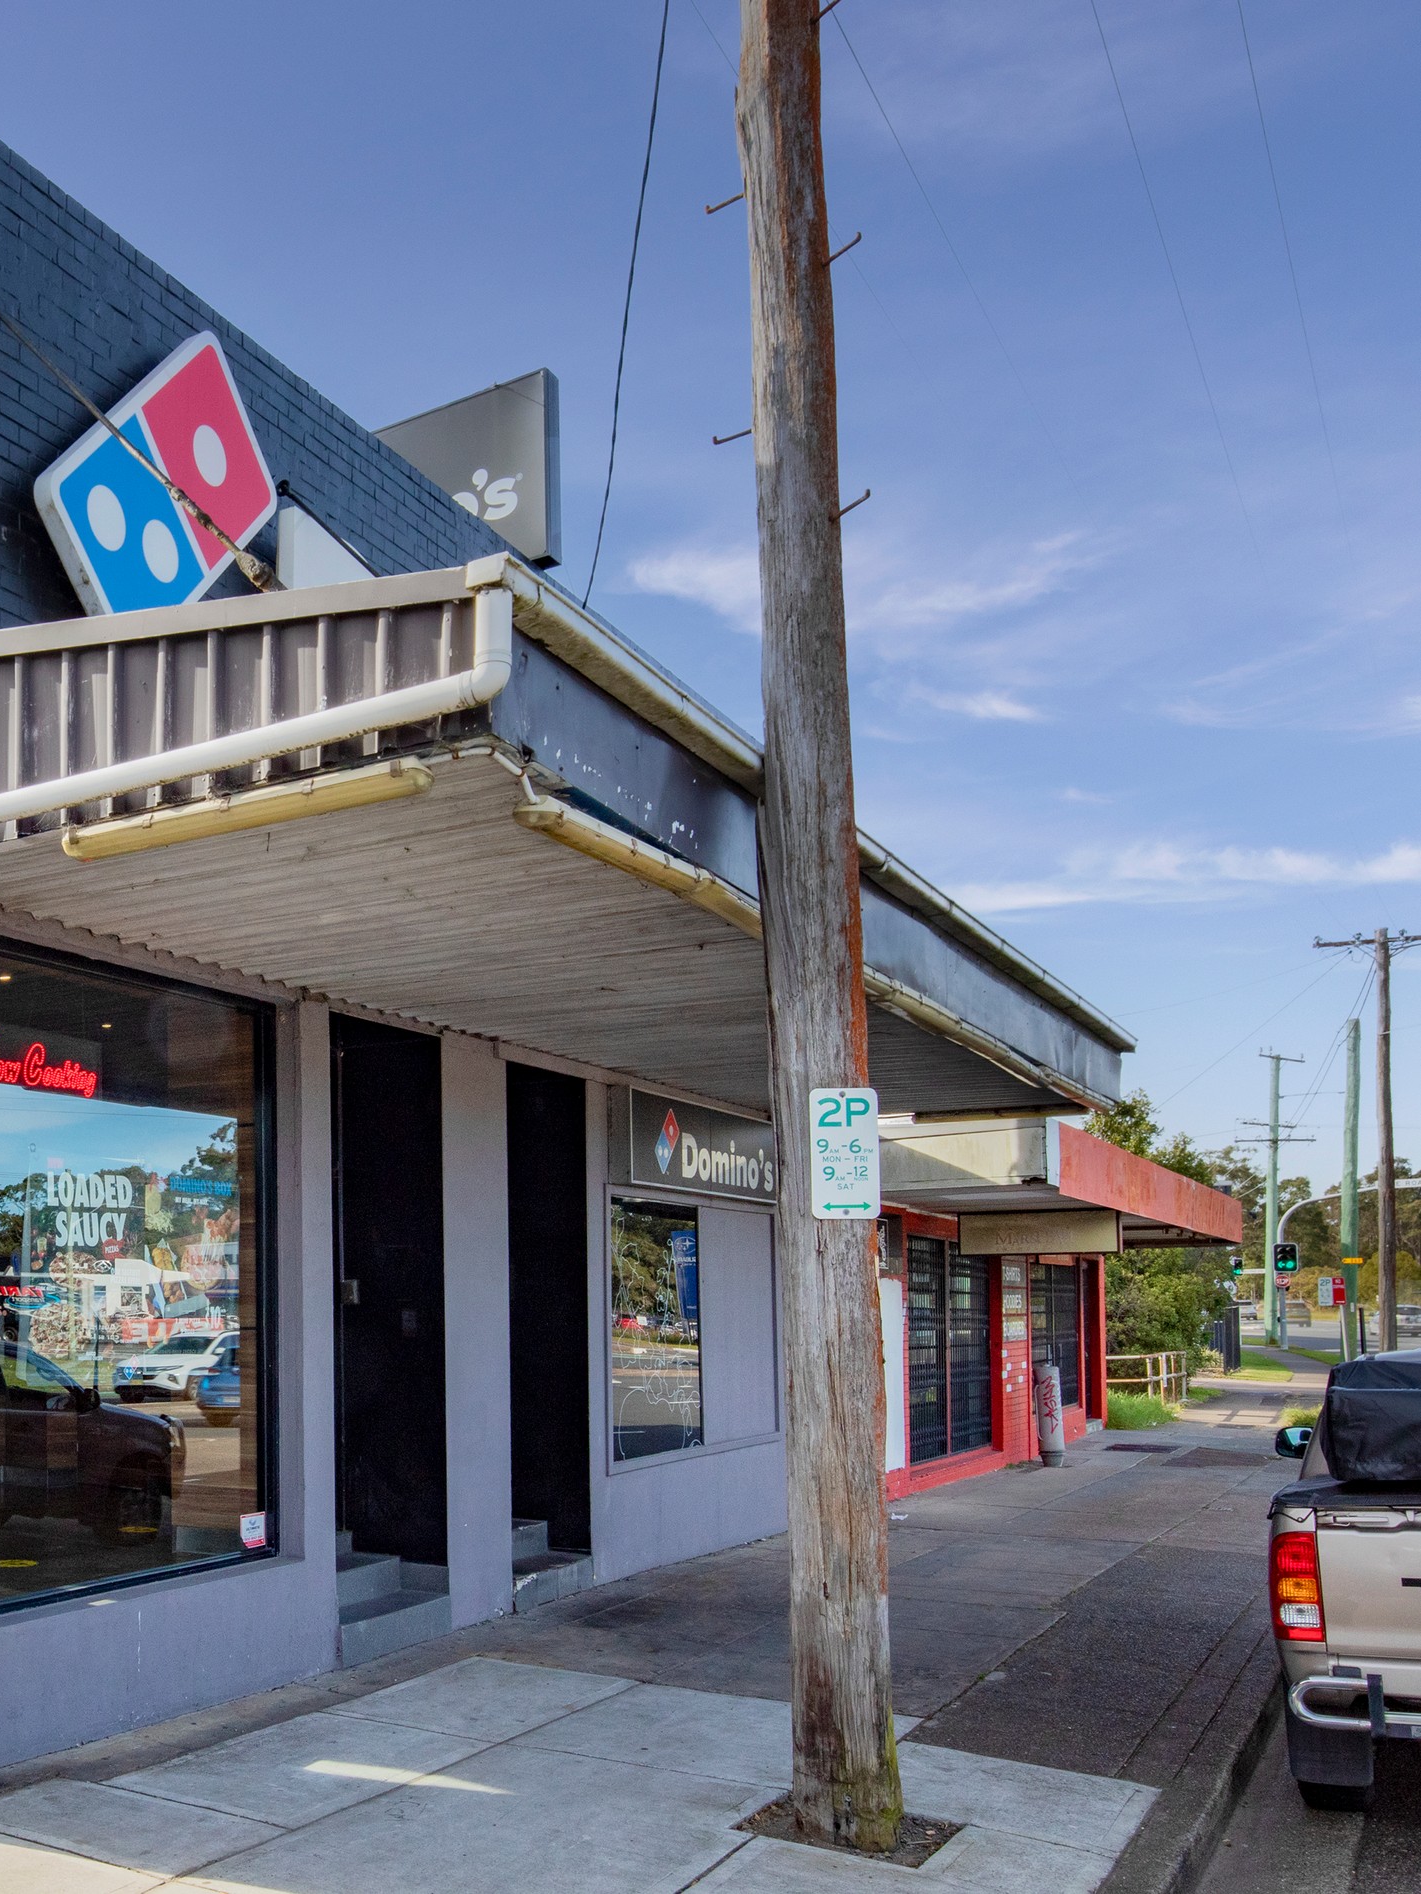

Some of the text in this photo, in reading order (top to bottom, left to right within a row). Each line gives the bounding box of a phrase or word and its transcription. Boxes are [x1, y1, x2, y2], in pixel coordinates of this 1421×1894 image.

[23, 1042, 97, 1098] Cooking
[817, 1097, 870, 1127] 2P
[682, 1132, 774, 1193] Domino's
[47, 1171, 132, 1208] LOADED
[56, 1211, 126, 1247] SAUCY
[1320, 1279, 1331, 1287] 2P
